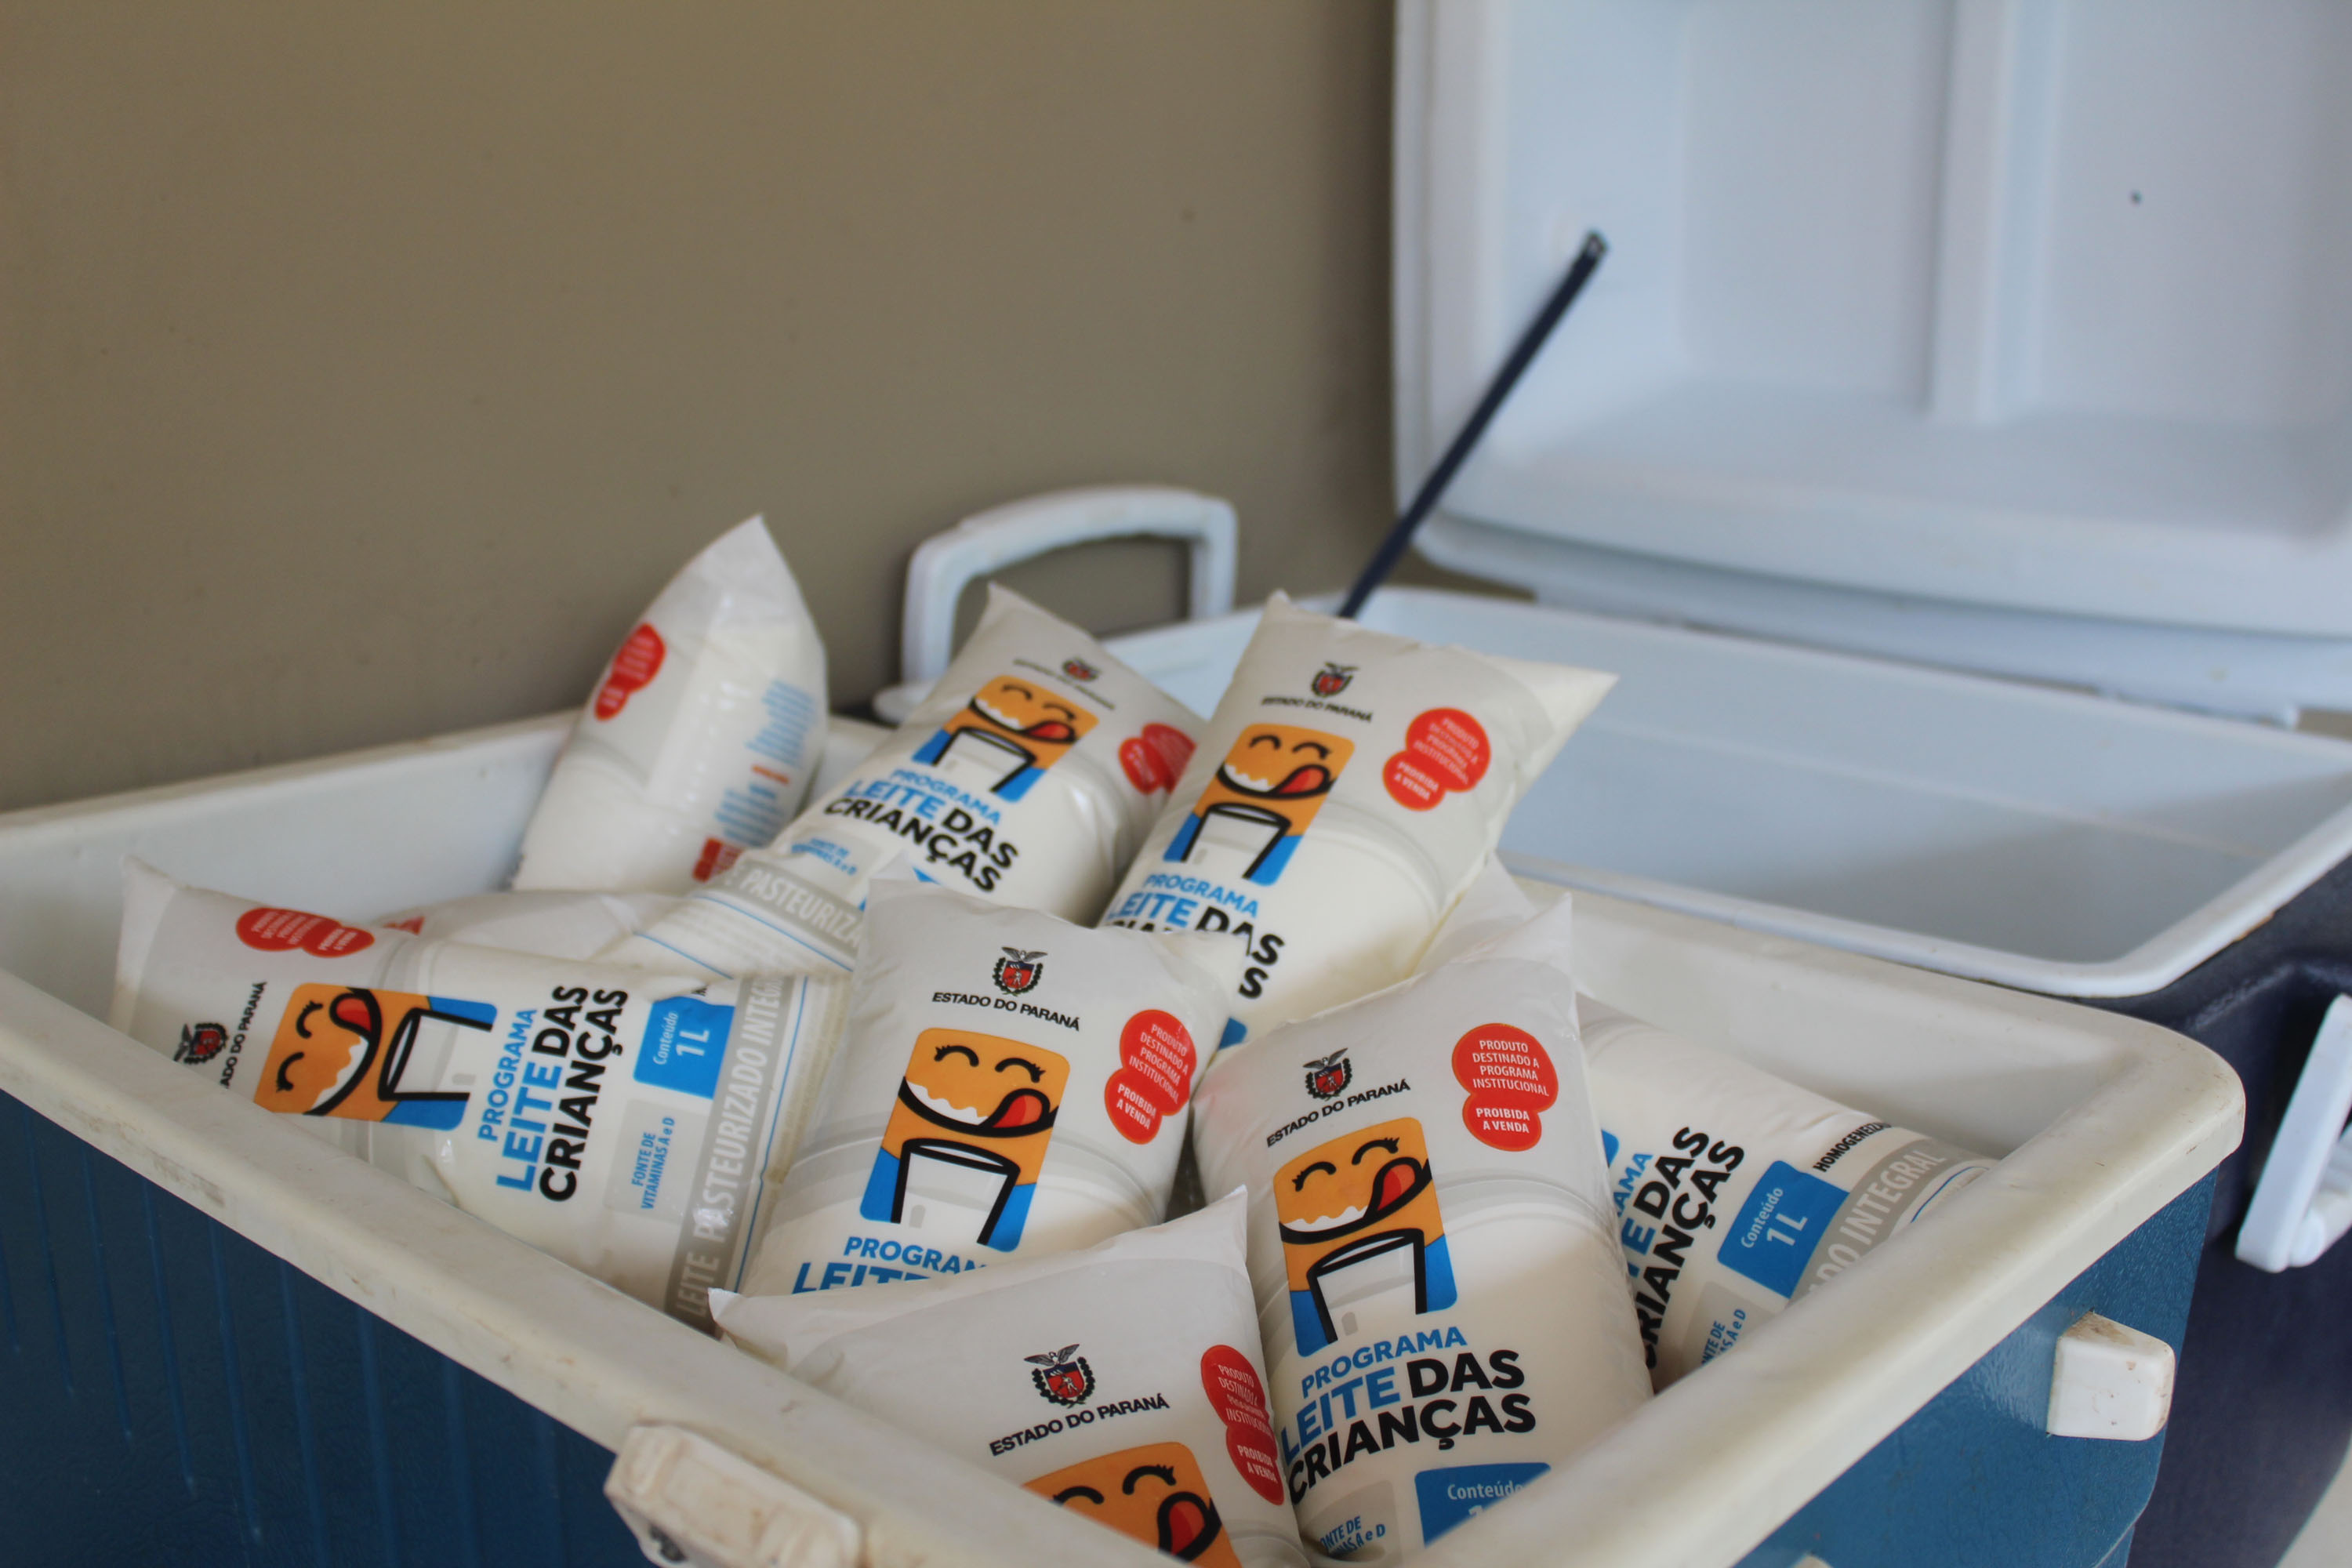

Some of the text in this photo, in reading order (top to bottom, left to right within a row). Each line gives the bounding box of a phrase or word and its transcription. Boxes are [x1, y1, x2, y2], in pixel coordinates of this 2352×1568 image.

[891, 768, 1001, 825] PROGRAMA
[824, 797, 1002, 892] CRIANÇAS
[844, 780, 946, 820] LEITE
[942, 807, 1018, 869] DAS
[739, 868, 862, 947] PASTEURIZA
[1106, 892, 1198, 928] LEITE
[1142, 873, 1258, 918] PROGRAMA
[931, 991, 1080, 1033] ESTADO DO PARANÁ
[652, 1011, 679, 1065] Conteúdo
[1140, 1032, 1189, 1075] DESTINADO A
[1151, 1023, 1188, 1057] PRODUTO
[1479, 1040, 1529, 1053] PRODUTO
[220, 1056, 238, 1090] ADO
[230, 1033, 245, 1054] DO
[477, 1009, 537, 1142] PROGRAMA
[1129, 1055, 1179, 1105] INSTITUCIONAL
[1140, 1047, 1181, 1087] PROGRAMA
[1472, 1053, 1540, 1069] DESTINADO A
[1479, 1065, 1538, 1081] PROGRAMA
[495, 985, 589, 1192] LEITE DAS
[539, 989, 628, 1202] CRIANÇAS
[1117, 1083, 1157, 1119] PROIBIDA
[1472, 1078, 1549, 1097] INSTITUCIONAL
[1116, 1098, 1151, 1130] A VENDA
[1265, 1078, 1411, 1148] ESTADO DO PARANÁ
[1475, 1108, 1530, 1121] PROIBIDA
[1483, 1121, 1530, 1134] A VENDA
[631, 1131, 656, 1187] FONTE DE
[641, 1116, 675, 1210] VITAMINAS A e D
[676, 1251, 720, 1316] LEITE
[741, 978, 783, 1046] INTEG
[1813, 1122, 1891, 1173] HOMOGENEIZ
[1633, 1127, 1710, 1220] DAS
[1740, 1187, 1784, 1249] Conteúdo
[1839, 1150, 1947, 1245] INTEGRAL
[843, 1236, 988, 1276] PROGRA
[792, 1262, 931, 1294] LEIT
[1710, 1320, 1726, 1340] DE
[1726, 1330, 1739, 1341] A
[1733, 1308, 1746, 1321] D
[1733, 1321, 1742, 1330] e
[1218, 1364, 1254, 1388] PRODUTO
[1301, 1326, 1468, 1399] PROGRAMA
[1218, 1377, 1254, 1404] DESTINADO
[1280, 1349, 1525, 1463] LEITE DAS
[989, 1392, 1171, 1457] ESTADO DO PARANÁ
[1236, 1444, 1275, 1468] PROIBIDA
[1288, 1392, 1537, 1506] CRIANÇAS
[1247, 1462, 1279, 1484] A VENDA
[1320, 1524, 1346, 1551] ONTE
[1346, 1515, 1363, 1531] DE
[1356, 1535, 1365, 1548] A
[1365, 1531, 1374, 1542] e
[1376, 1523, 1386, 1538] D
